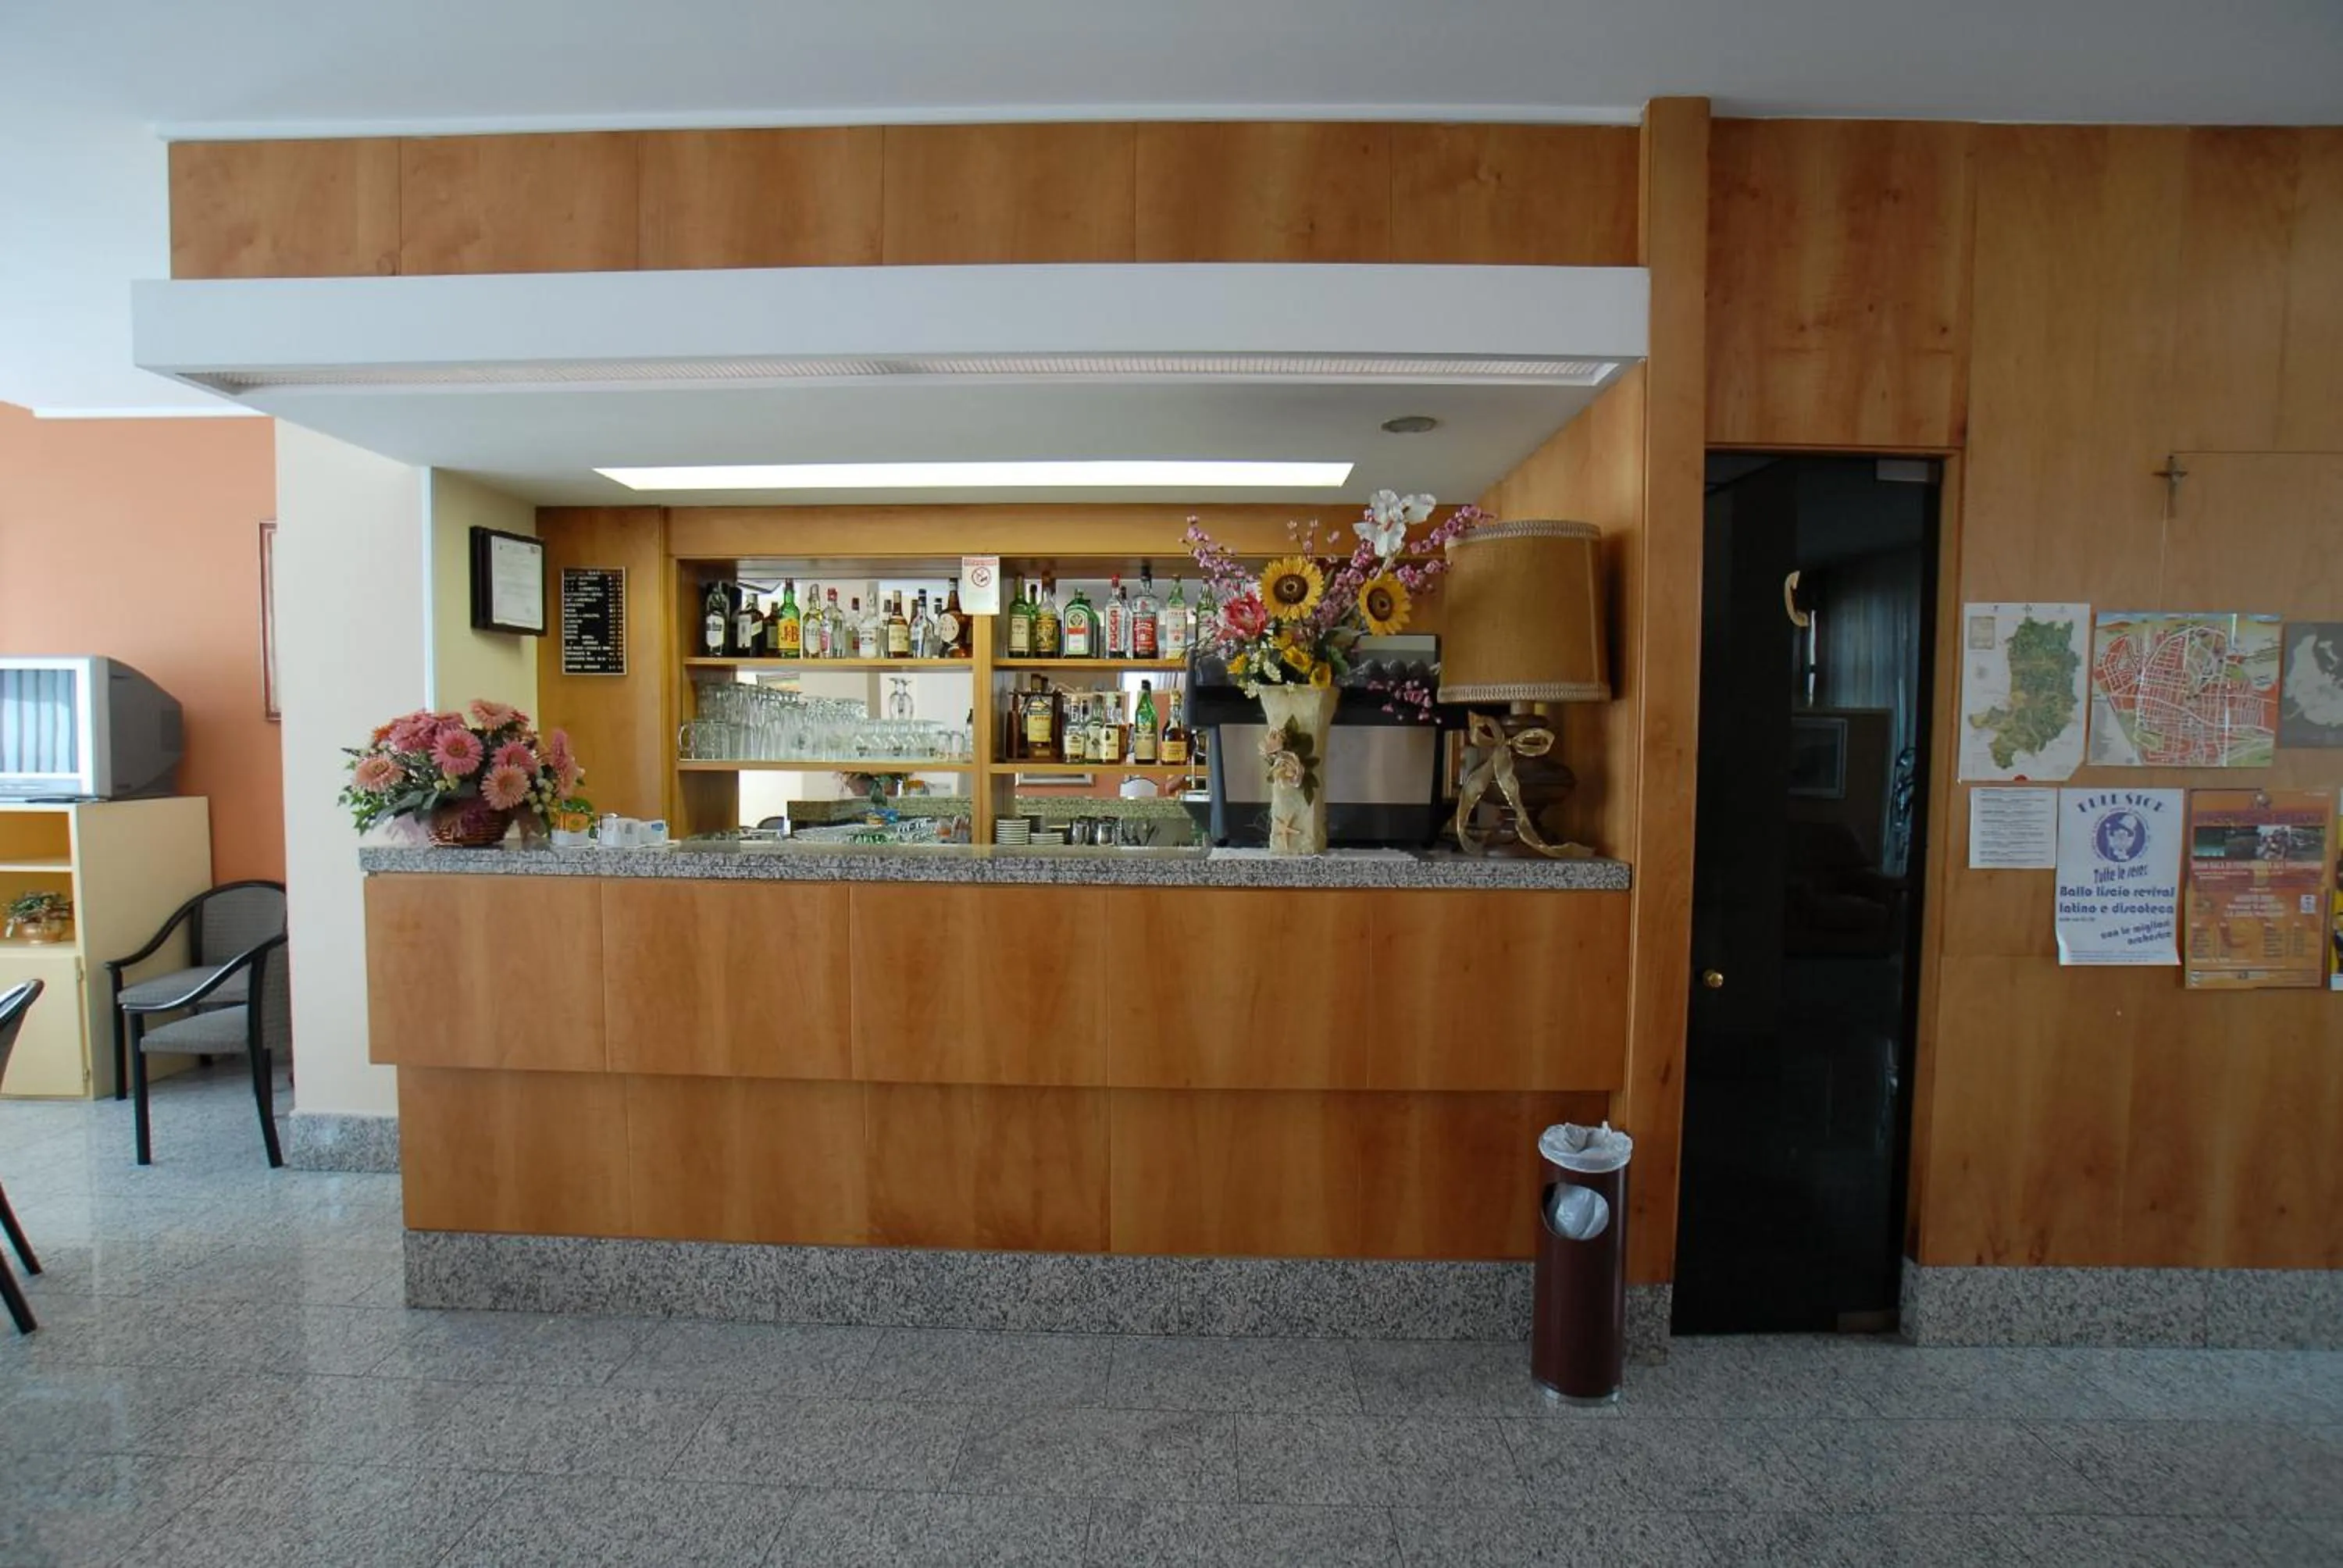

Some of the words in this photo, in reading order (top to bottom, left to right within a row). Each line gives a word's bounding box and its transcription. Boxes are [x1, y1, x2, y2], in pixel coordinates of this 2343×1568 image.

[2059, 886, 2092, 897] Ballo
[2096, 886, 2130, 897] liscio
[2134, 886, 2175, 897] revival
[2059, 903, 2097, 914] latino
[2111, 903, 2174, 914] discoteca
